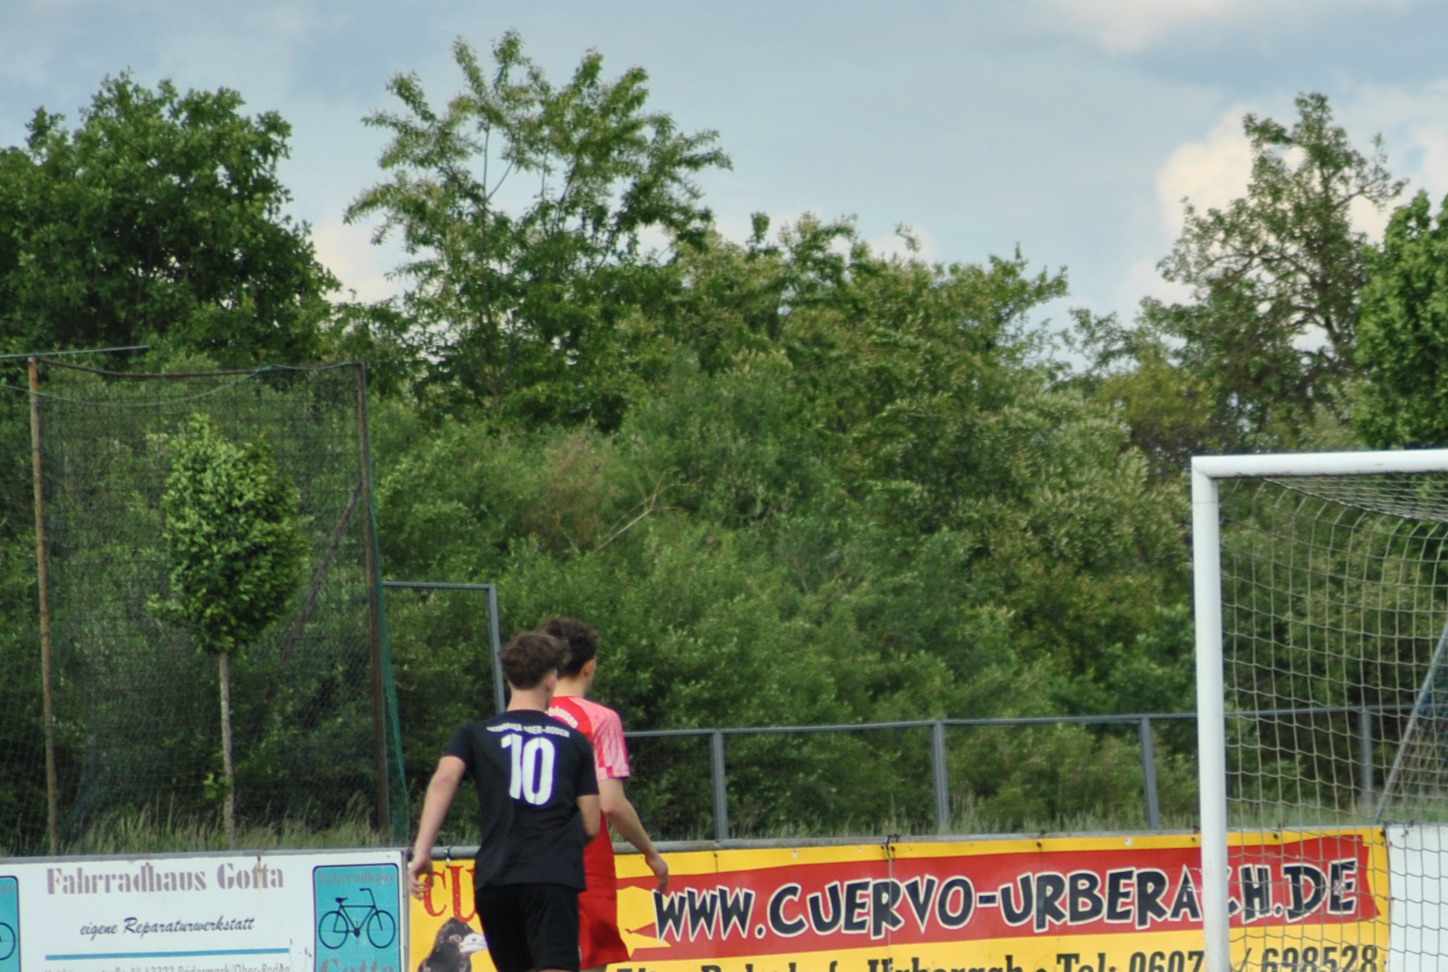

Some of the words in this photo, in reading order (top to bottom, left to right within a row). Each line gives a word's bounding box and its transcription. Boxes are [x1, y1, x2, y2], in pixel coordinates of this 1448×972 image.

[501, 733, 555, 805] 10
[47, 862, 207, 895] Fahrradhaus
[217, 863, 284, 890] Gotta
[652, 857, 1358, 943] WWW.CUERVO-URBERAH.DE
[80, 921, 117, 941] eigene
[123, 915, 255, 938] Reparaturwerkstatt
